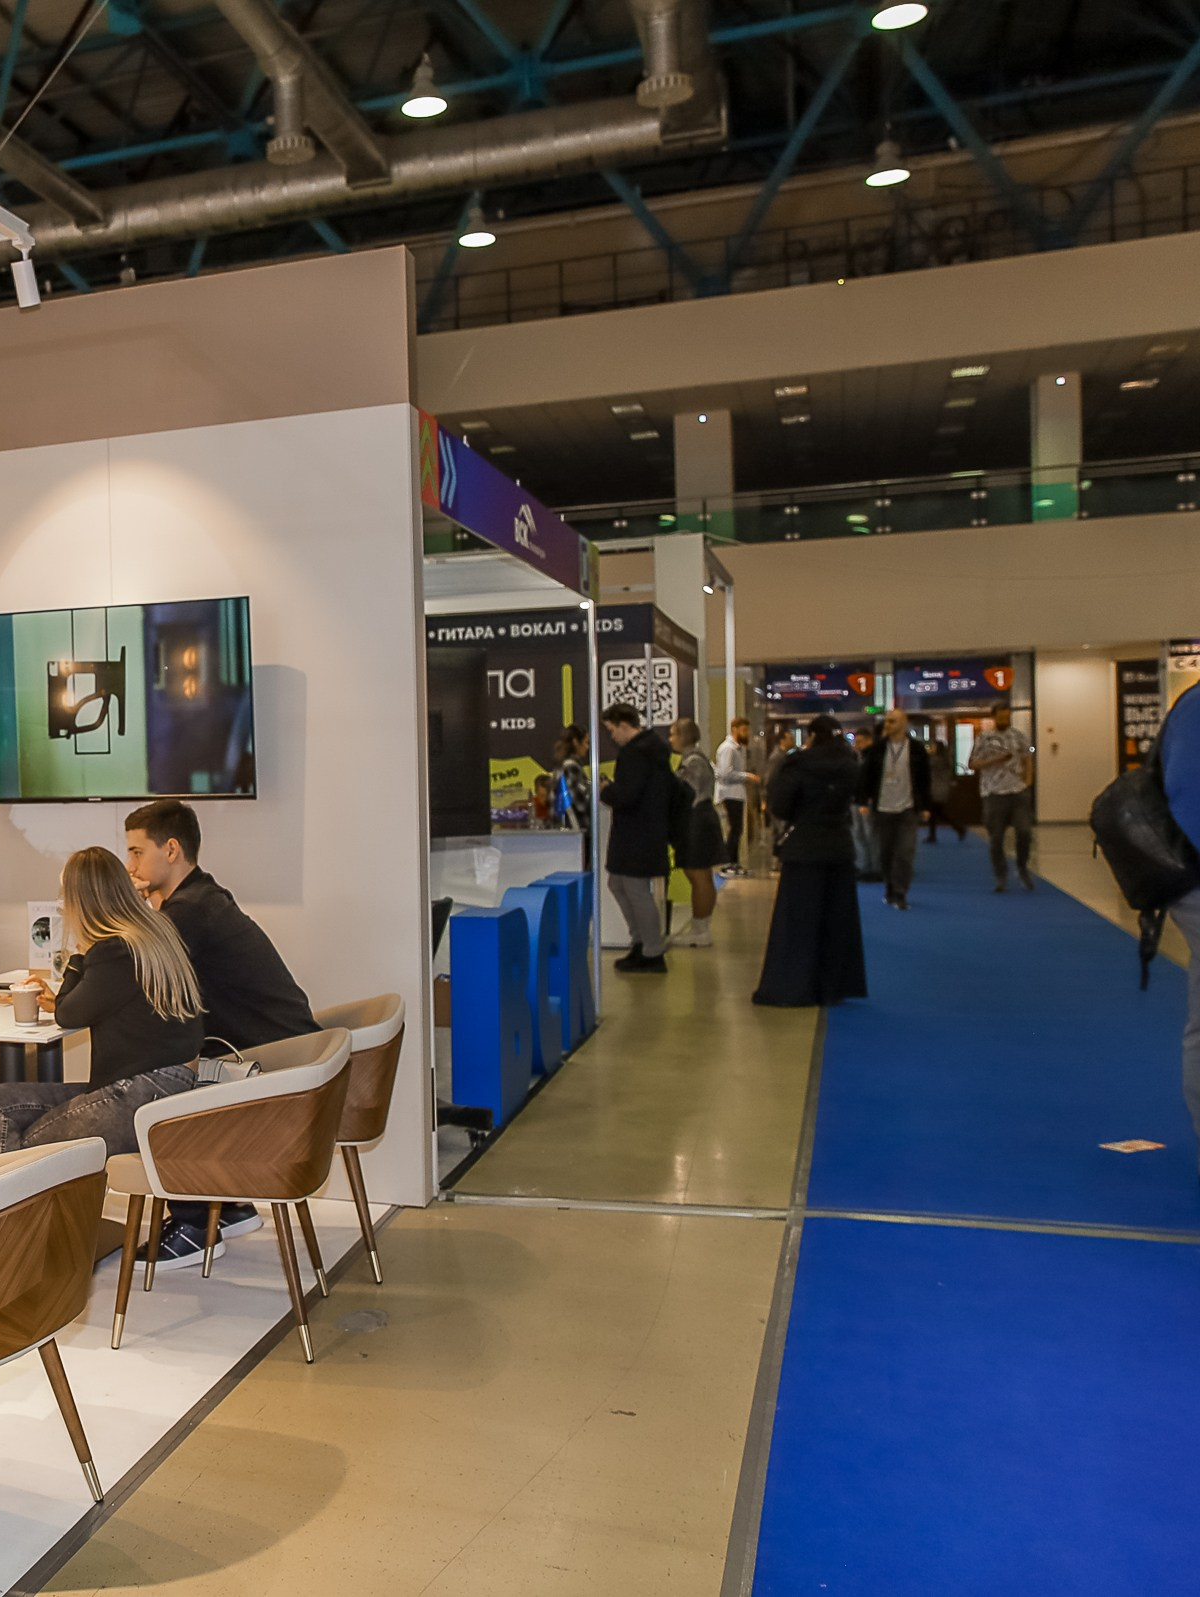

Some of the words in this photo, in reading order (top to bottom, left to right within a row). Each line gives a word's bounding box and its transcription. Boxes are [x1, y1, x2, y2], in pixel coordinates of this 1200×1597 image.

[437, 625, 495, 641] ГИТАРА
[510, 621, 566, 637] ВОКАЛ
[857, 677, 867, 692] 1
[994, 670, 1004, 687] 1
[501, 717, 536, 730] KIDS
